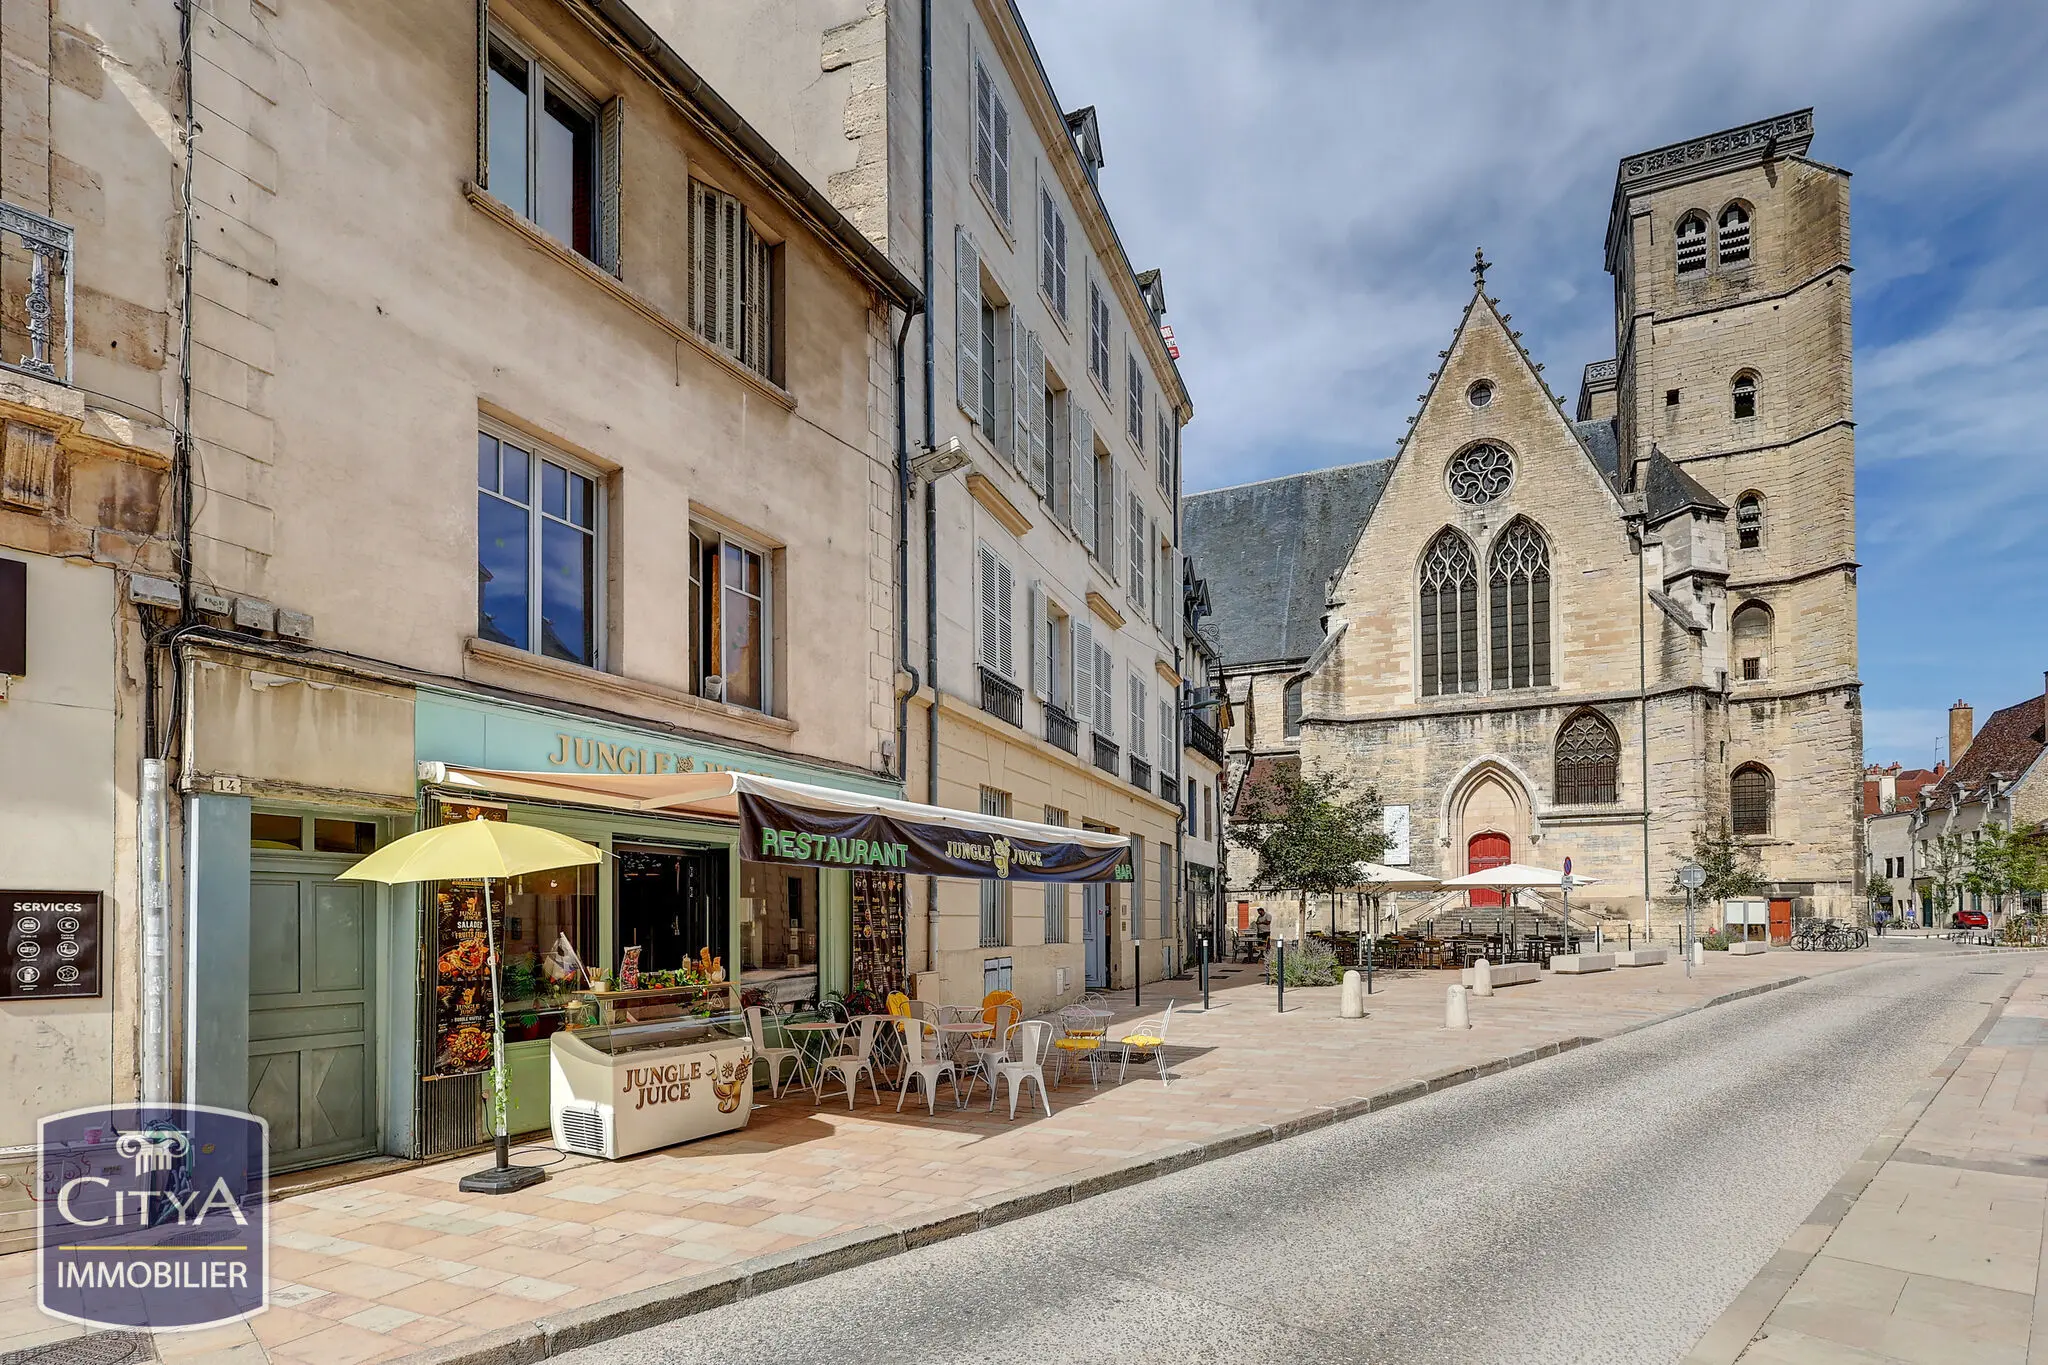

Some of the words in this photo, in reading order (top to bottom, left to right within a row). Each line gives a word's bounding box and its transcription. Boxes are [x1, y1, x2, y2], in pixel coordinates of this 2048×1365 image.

[550, 733, 671, 775] JUNGLE
[219, 779, 235, 791] 14
[762, 827, 909, 867] RESTAURANT
[945, 840, 992, 862] JUNGLE
[1011, 848, 1043, 867] JUICE
[1114, 864, 1133, 880] BAR
[13, 902, 82, 912] SERVICES
[455, 1003, 480, 1011] JUNGLE
[623, 1061, 702, 1093] JUNGLE
[635, 1082, 691, 1110] JUICE
